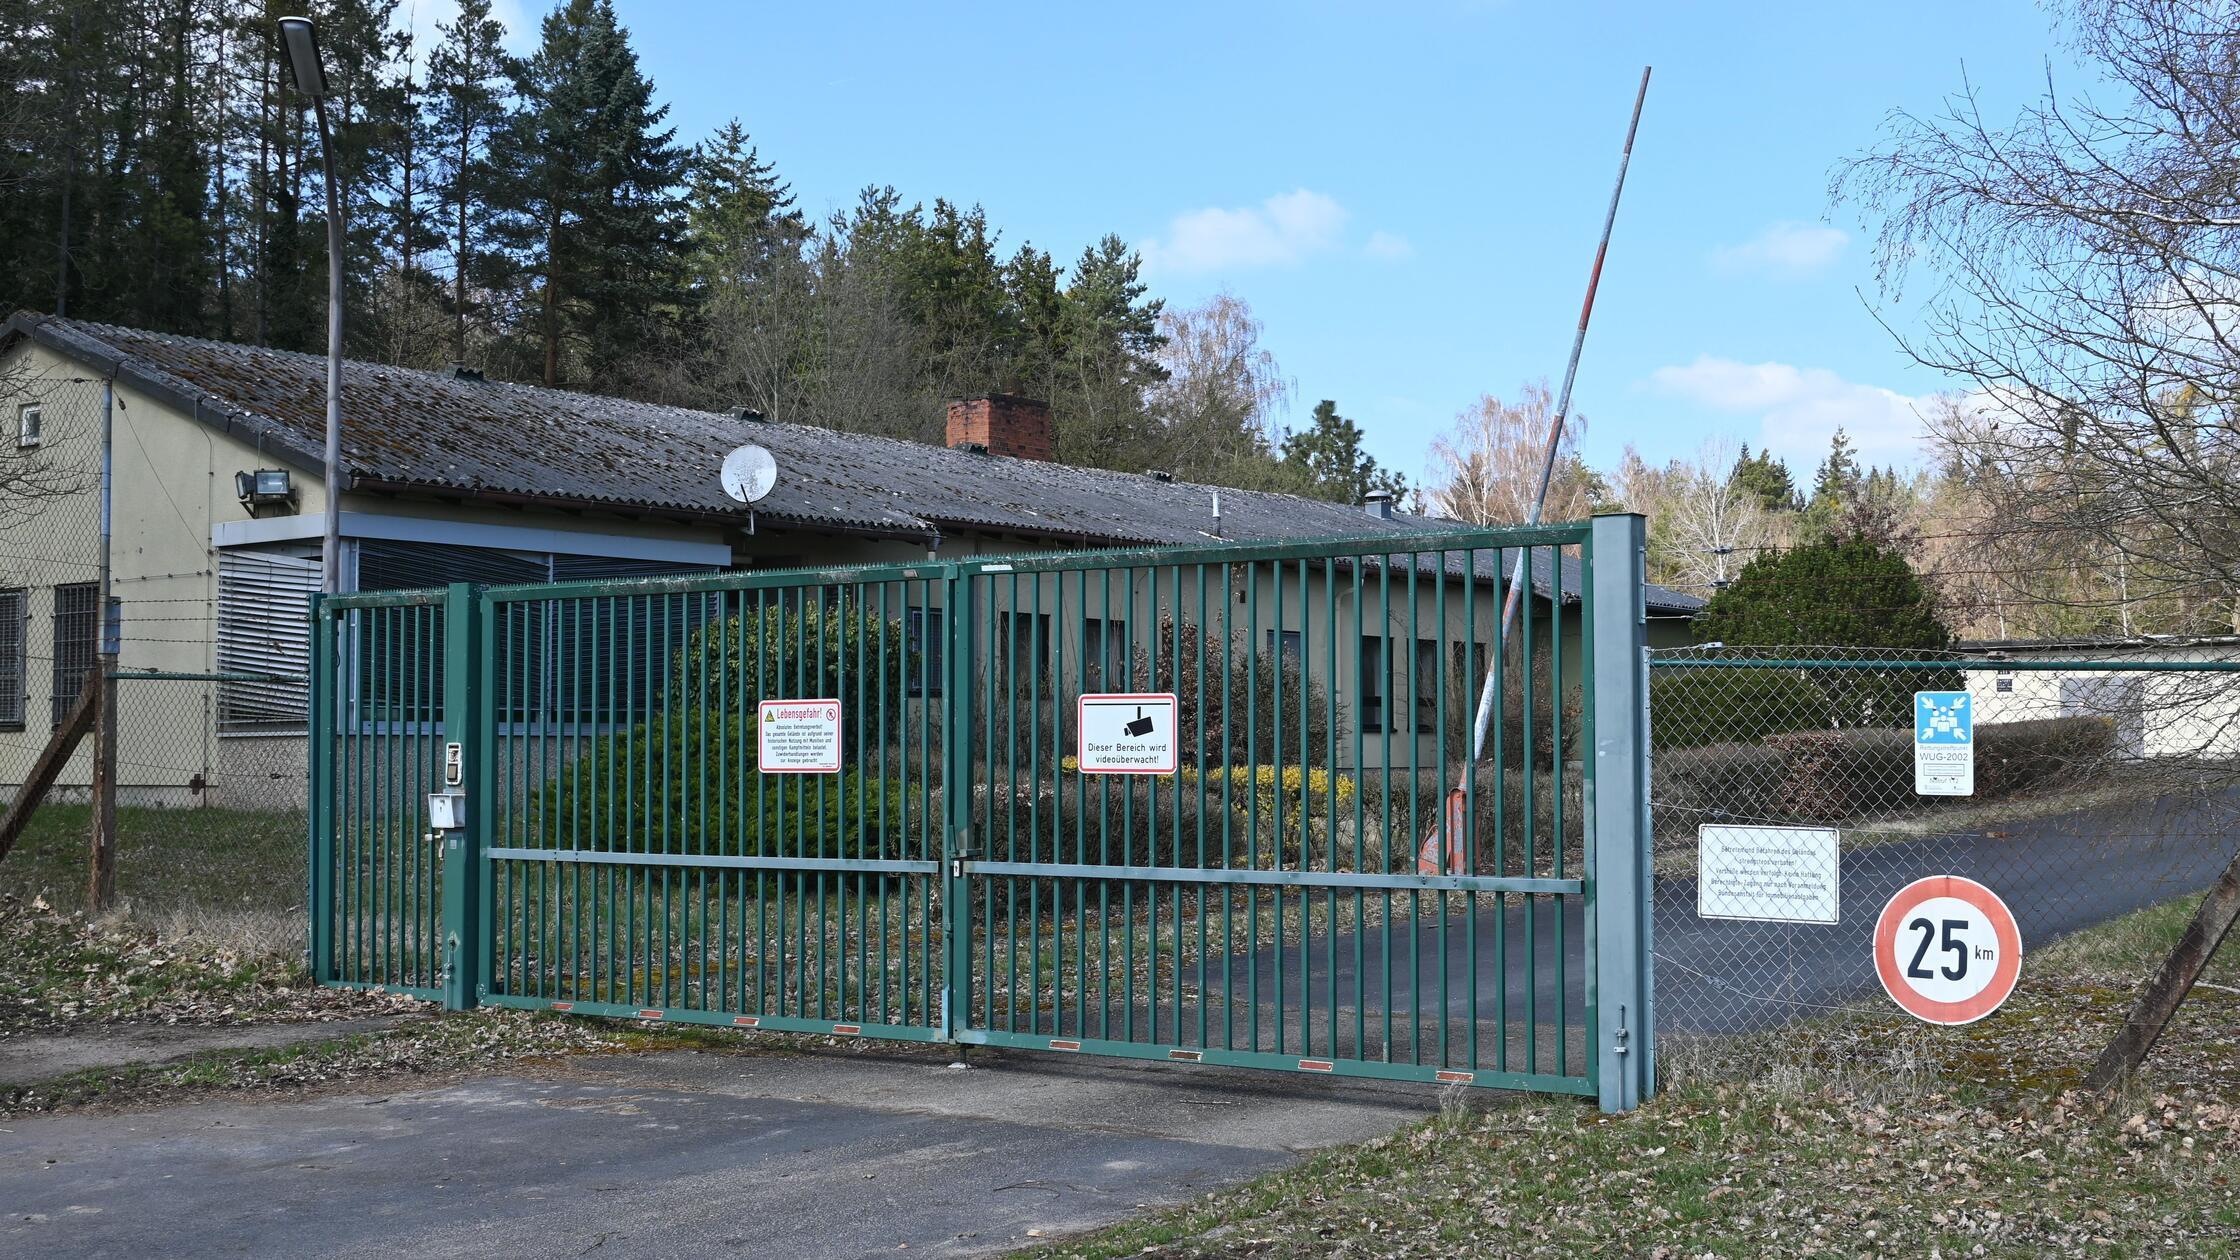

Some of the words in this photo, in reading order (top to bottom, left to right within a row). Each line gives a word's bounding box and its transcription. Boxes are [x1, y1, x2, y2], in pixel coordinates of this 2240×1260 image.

[777, 708, 822, 721] Lebensgefahr!
[1088, 743, 1112, 752] Dieser
[1116, 743, 1146, 752] Bereich
[1149, 744, 1166, 752] wird
[1096, 755, 1159, 764] videoüberwacht!
[1920, 752, 1968, 761] WUG-2002
[1907, 917, 1969, 982] 25
[1975, 945, 1993, 960] km
